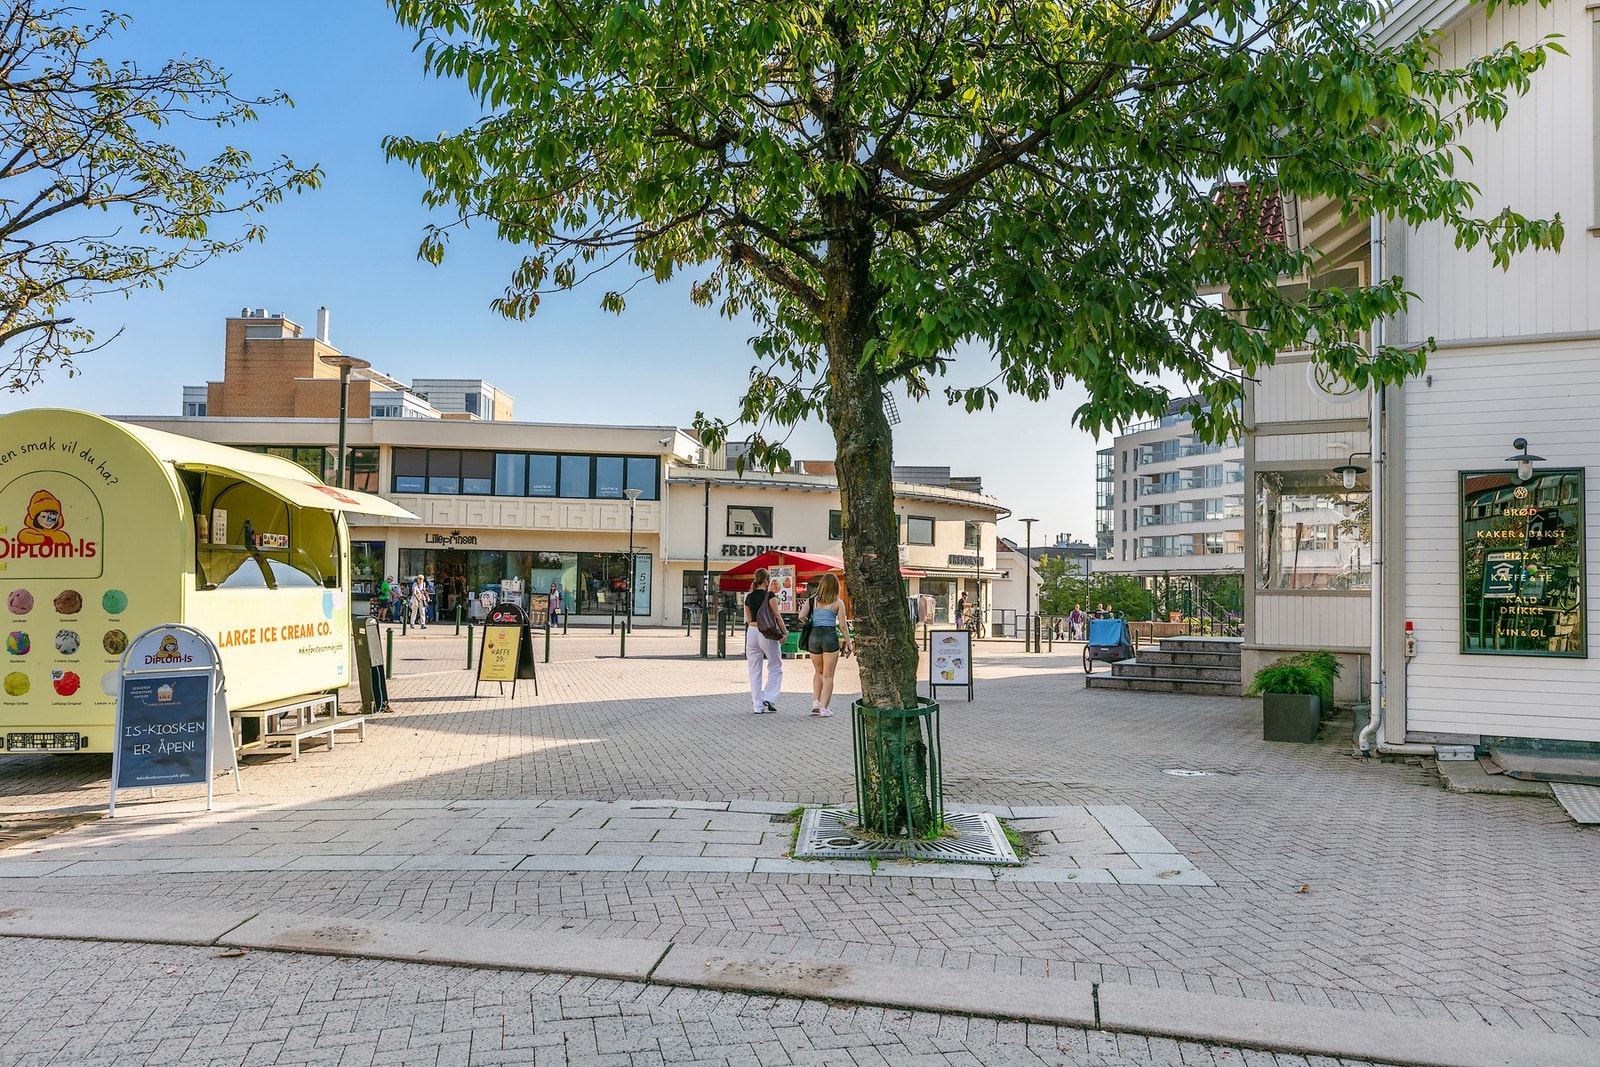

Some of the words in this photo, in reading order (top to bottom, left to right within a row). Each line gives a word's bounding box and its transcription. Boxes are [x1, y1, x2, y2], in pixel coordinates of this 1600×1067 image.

[20, 436, 56, 454] smak
[62, 441, 78, 454] vil
[80, 448, 95, 464] du
[96, 460, 118, 485] ha?
[1528, 530, 1566, 538] BAKST
[426, 533, 478, 546] Lilleprinsen
[640, 573, 646, 582] 5
[1538, 574, 1552, 582] TE
[640, 586, 645, 594] 4
[782, 591, 787, 602] 3
[1500, 606, 1544, 615] DRIKKE
[218, 628, 256, 648] LARGE
[260, 627, 277, 643] ICE
[281, 623, 314, 640] CREAM
[317, 622, 332, 636] CO.
[1530, 629, 1546, 637] ØL
[125, 722, 205, 736] IS-KIOSKEN
[134, 743, 152, 755] ER
[158, 738, 195, 755] ÅPEN!
